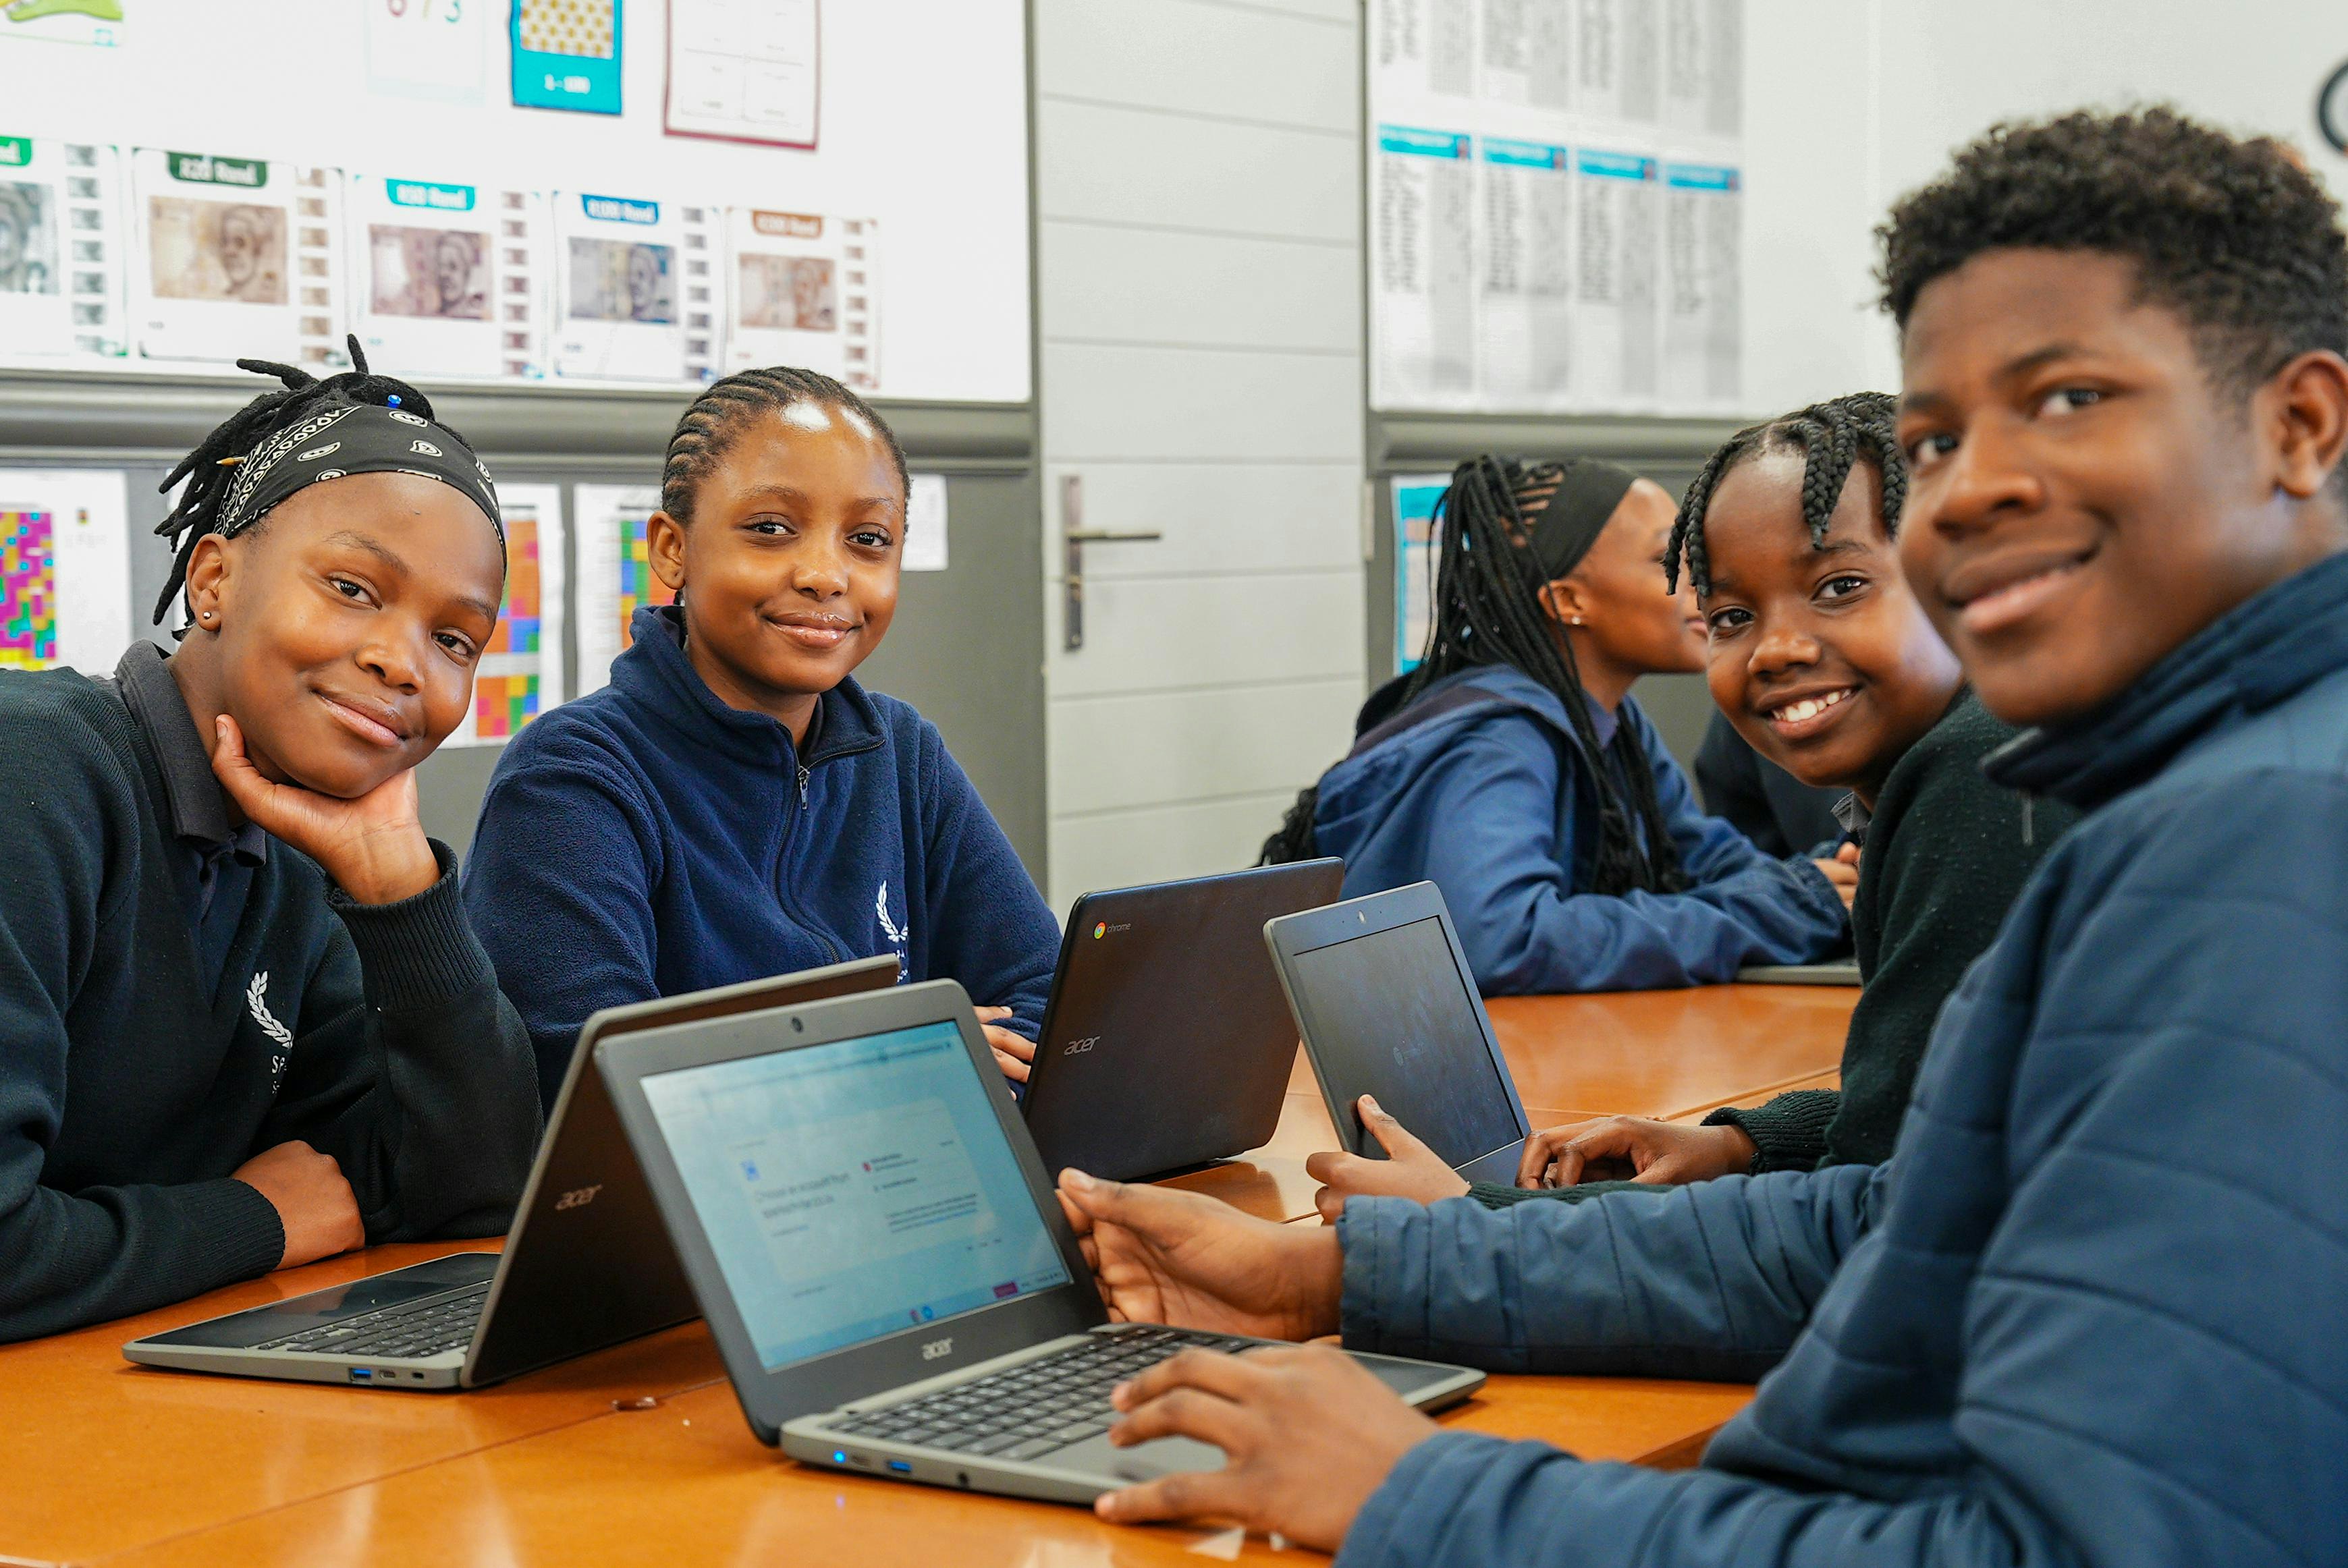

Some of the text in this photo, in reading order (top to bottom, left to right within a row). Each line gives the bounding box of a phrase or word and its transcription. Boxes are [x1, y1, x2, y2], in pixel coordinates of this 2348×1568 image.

[1107, 923, 1132, 933] chrome
[1064, 1036, 1101, 1056] acer
[555, 1184, 603, 1210] acer
[922, 1337, 953, 1361] acer
